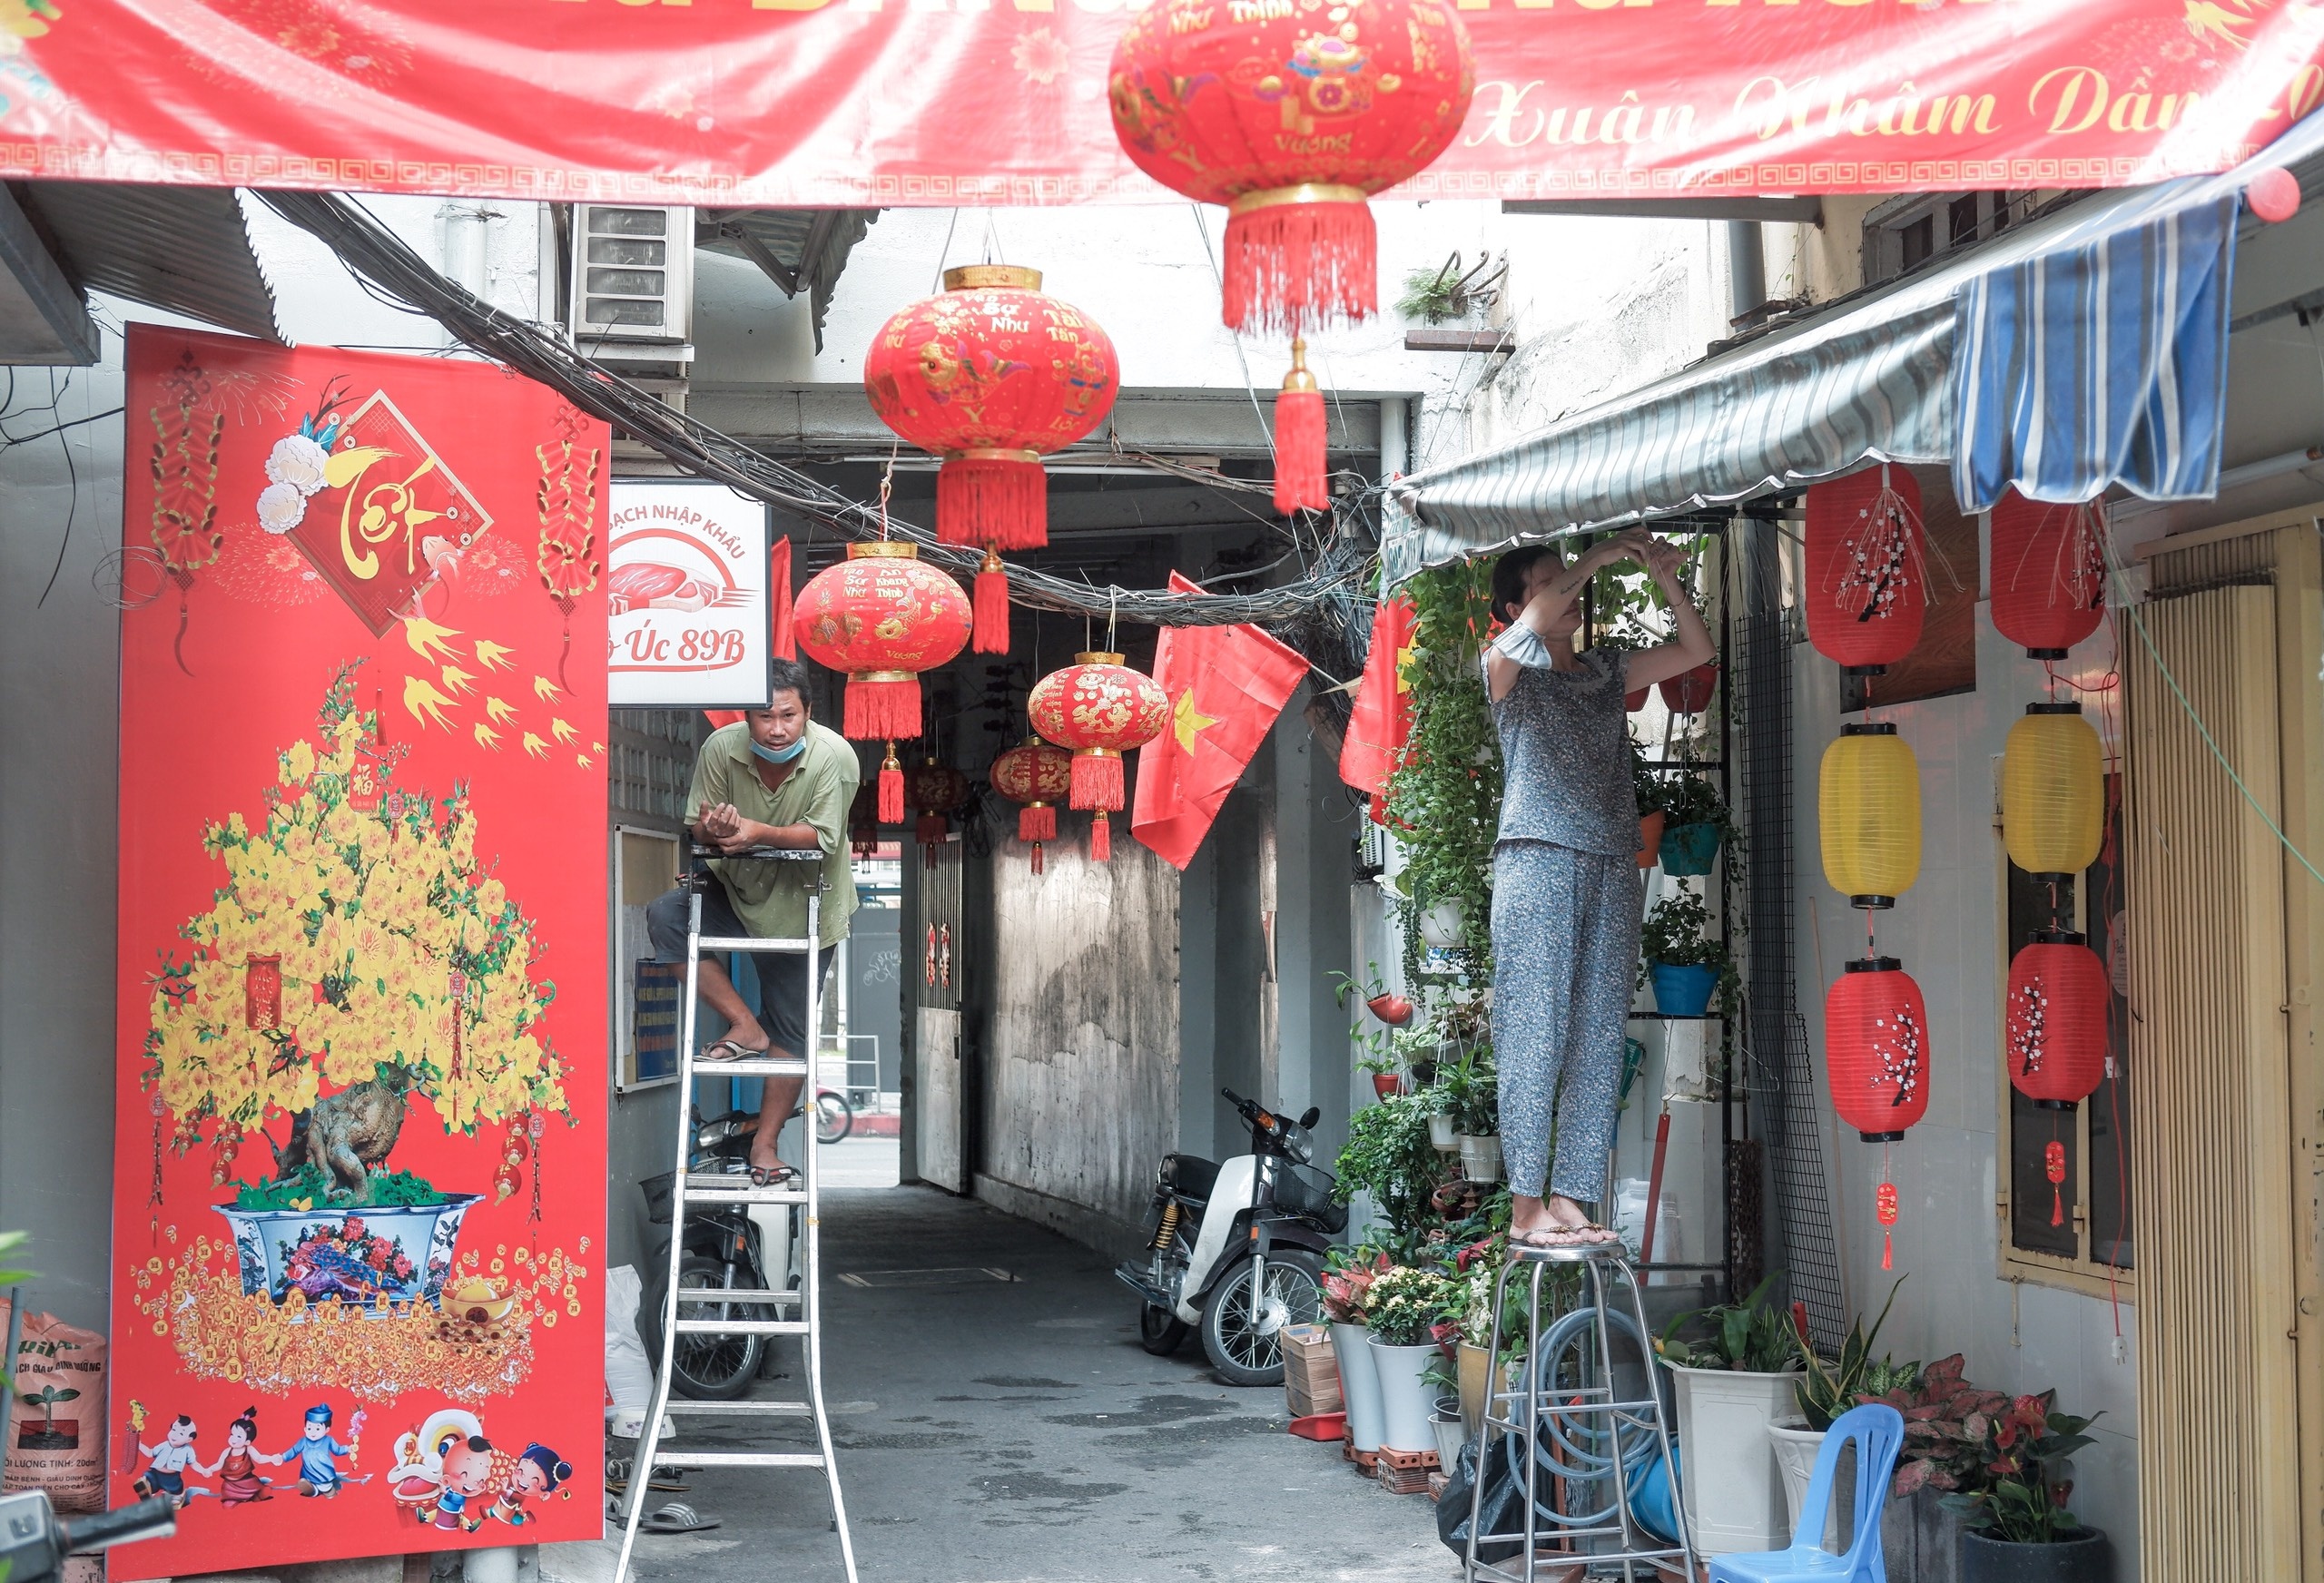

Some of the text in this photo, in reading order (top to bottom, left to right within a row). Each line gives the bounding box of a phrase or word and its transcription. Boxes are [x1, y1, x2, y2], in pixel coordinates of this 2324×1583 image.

[1462, 79, 1696, 147] Xuân
[1731, 74, 2003, 140] Nhâm
[652, 504, 703, 526] NHẬP
[702, 518, 746, 559] KHẨU
[624, 618, 671, 662] Úc
[677, 628, 746, 662] 89B
[353, 763, 374, 797] 福
[15, 1459, 47, 1470] LƯỢNG
